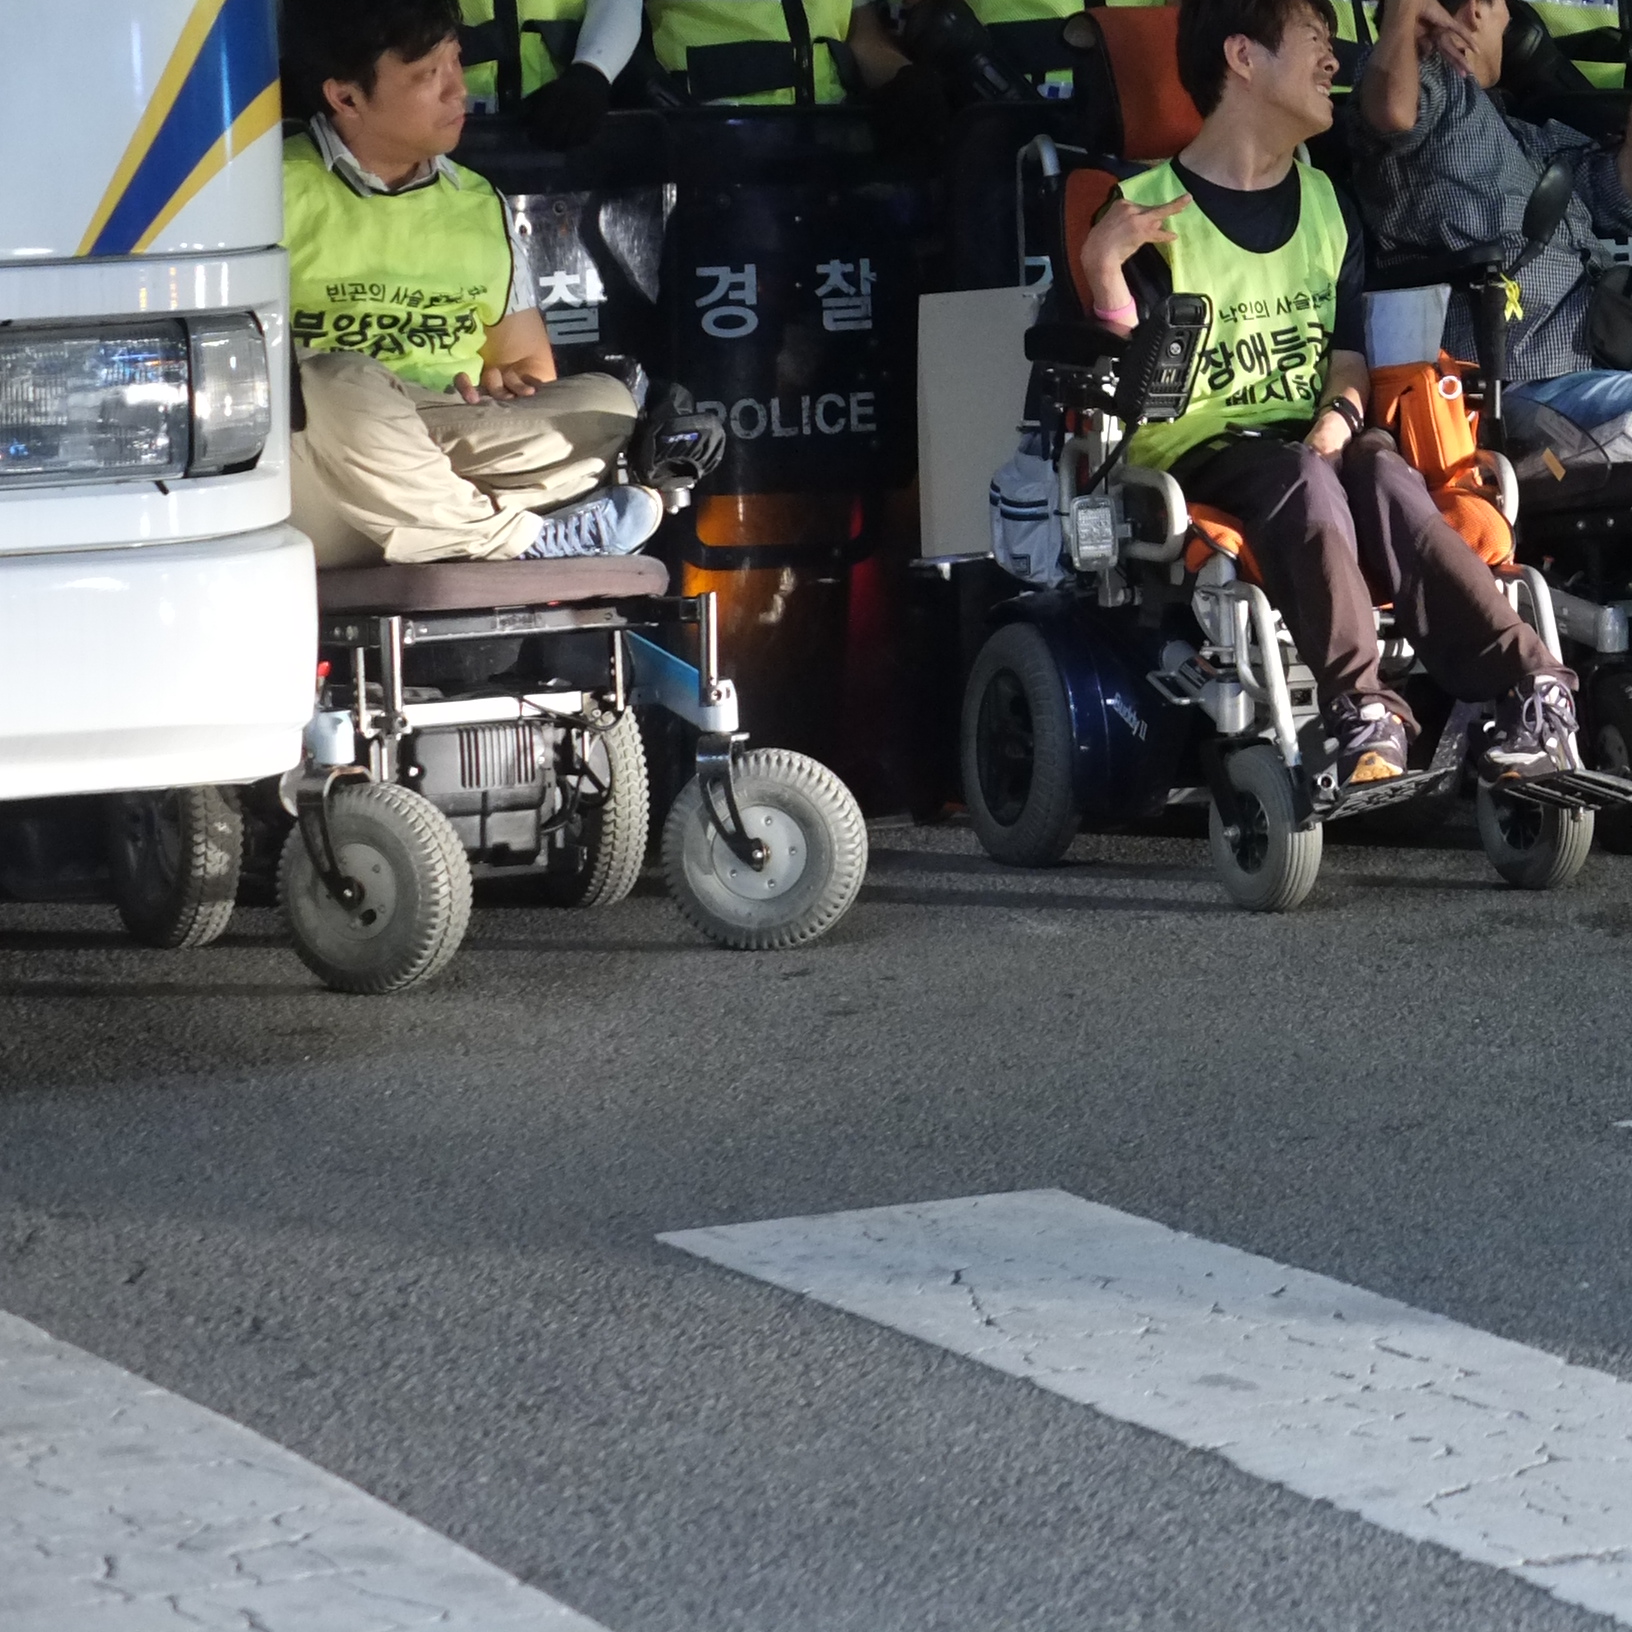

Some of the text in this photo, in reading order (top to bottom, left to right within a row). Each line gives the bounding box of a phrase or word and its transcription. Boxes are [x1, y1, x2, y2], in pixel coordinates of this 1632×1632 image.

[326, 282, 387, 303] 빈곤의
[390, 286, 425, 308] 사슬
[1218, 299, 1271, 324] 낙인의
[1276, 290, 1311, 316] 사슬
